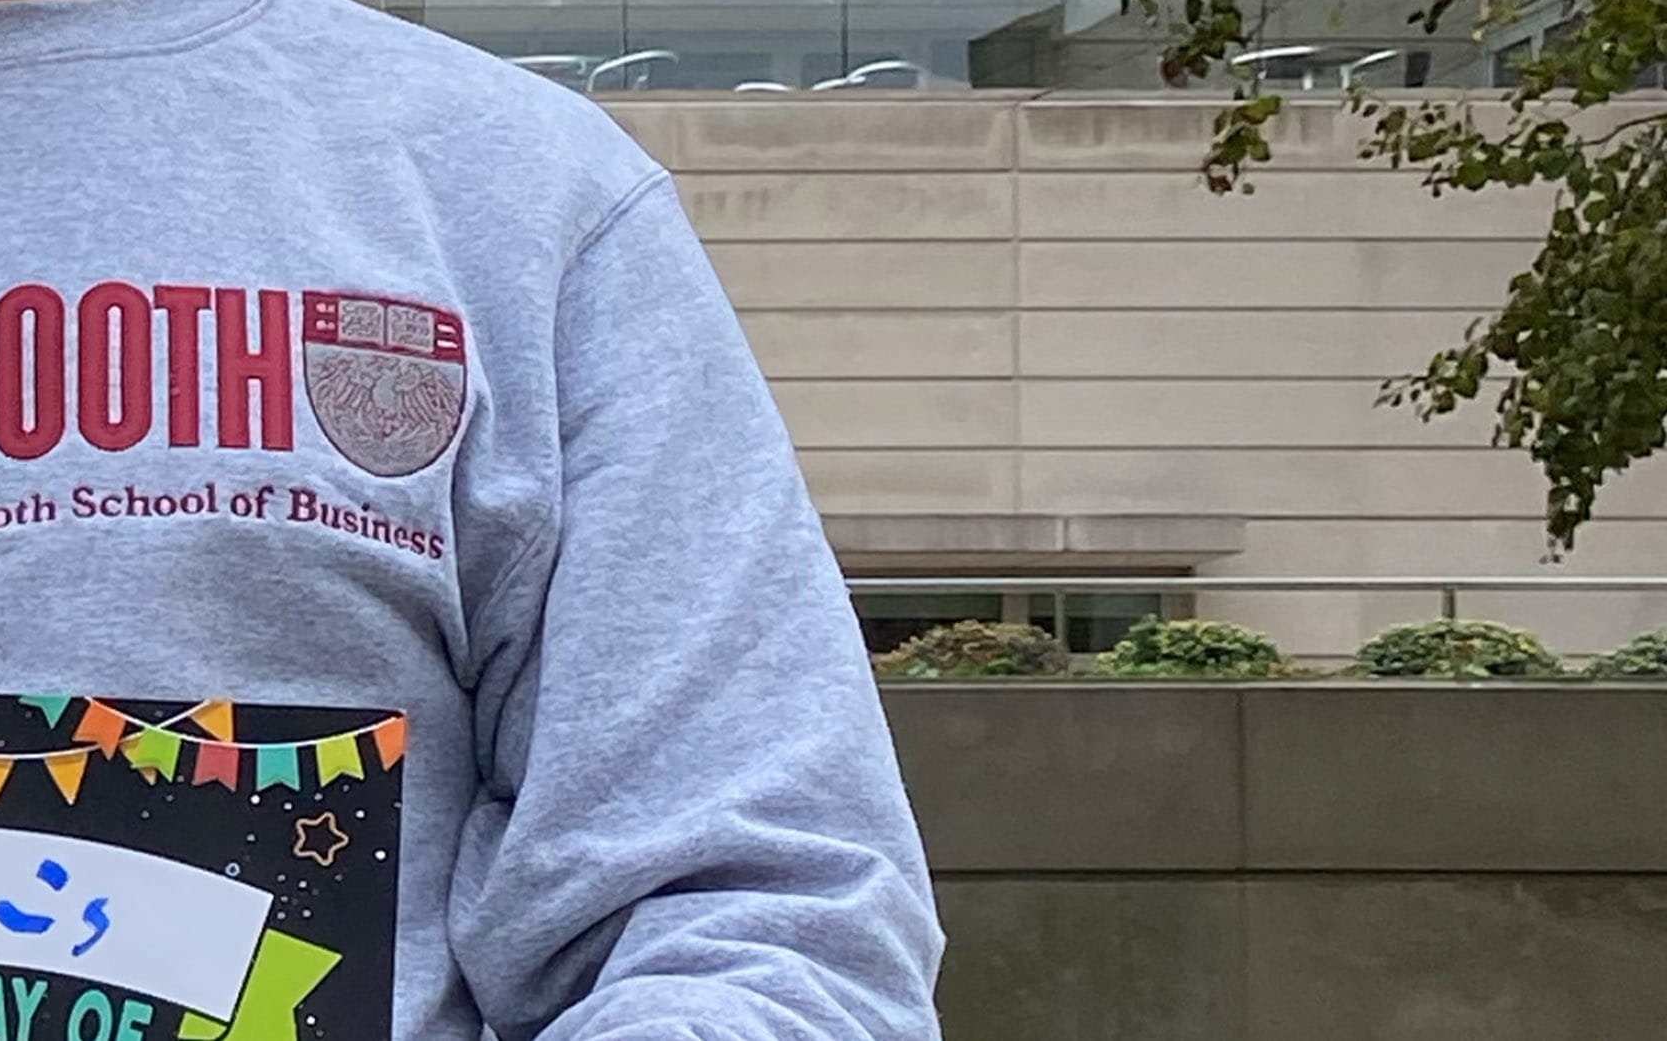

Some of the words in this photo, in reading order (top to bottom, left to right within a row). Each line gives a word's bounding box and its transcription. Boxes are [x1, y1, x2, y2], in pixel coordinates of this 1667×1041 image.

[71, 482, 209, 519] School
[230, 485, 274, 519] of
[286, 487, 445, 560] Business
[66, 988, 155, 1041] OF
